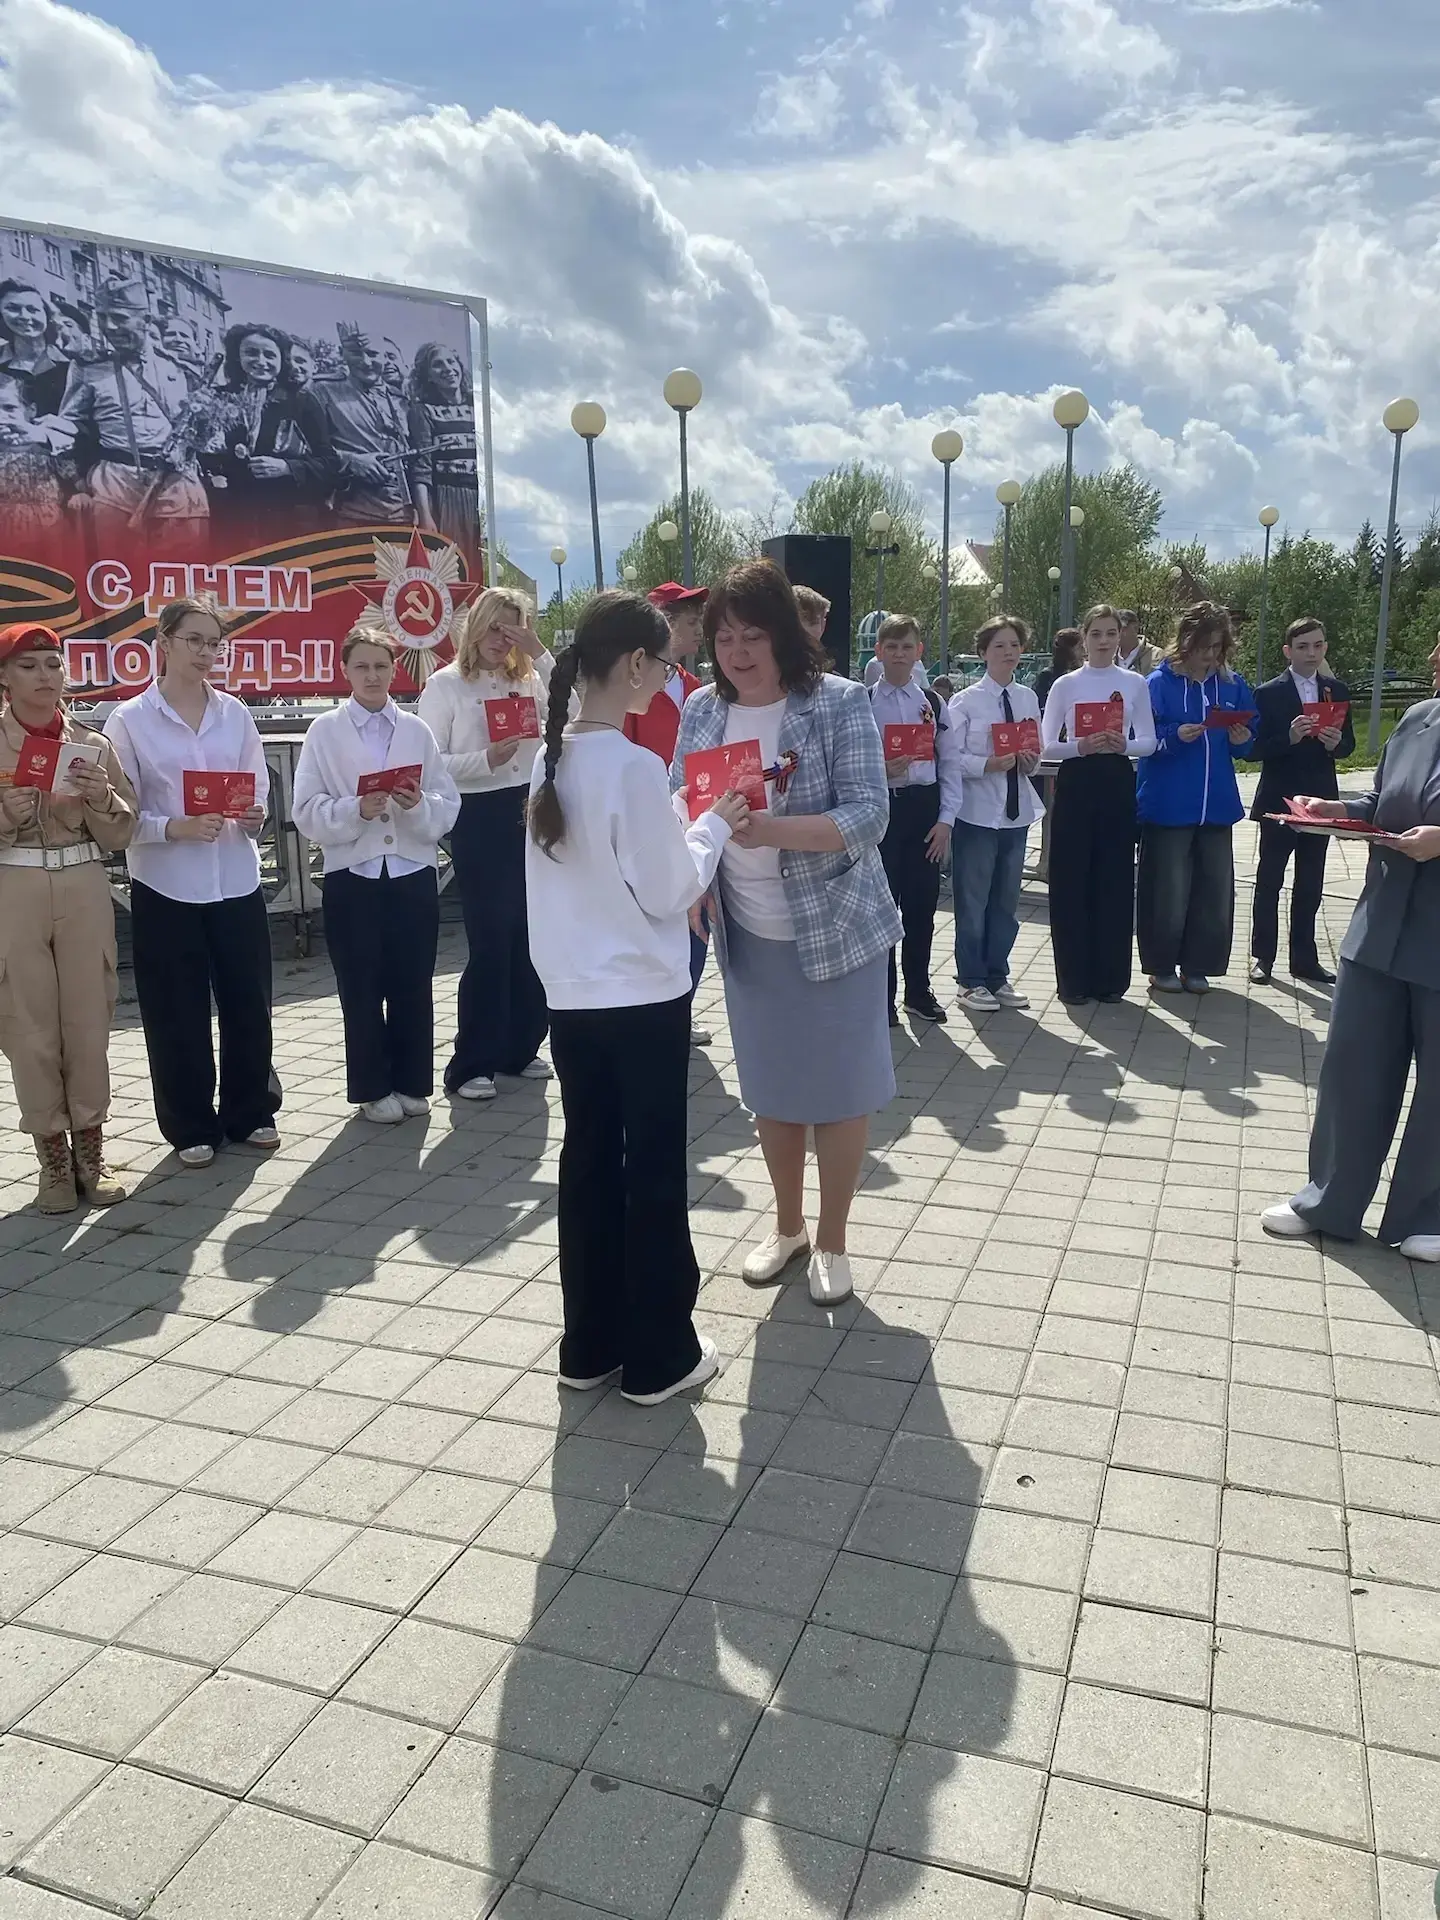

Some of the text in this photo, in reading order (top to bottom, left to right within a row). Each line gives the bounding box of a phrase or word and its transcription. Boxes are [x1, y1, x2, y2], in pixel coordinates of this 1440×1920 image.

[87, 560, 313, 618] С ДНЕМ
[384, 568, 452, 641] ОТЕЧЕСТВЕННАЯ ВОЙНА
[64, 638, 335, 691] ПОДЫ!
